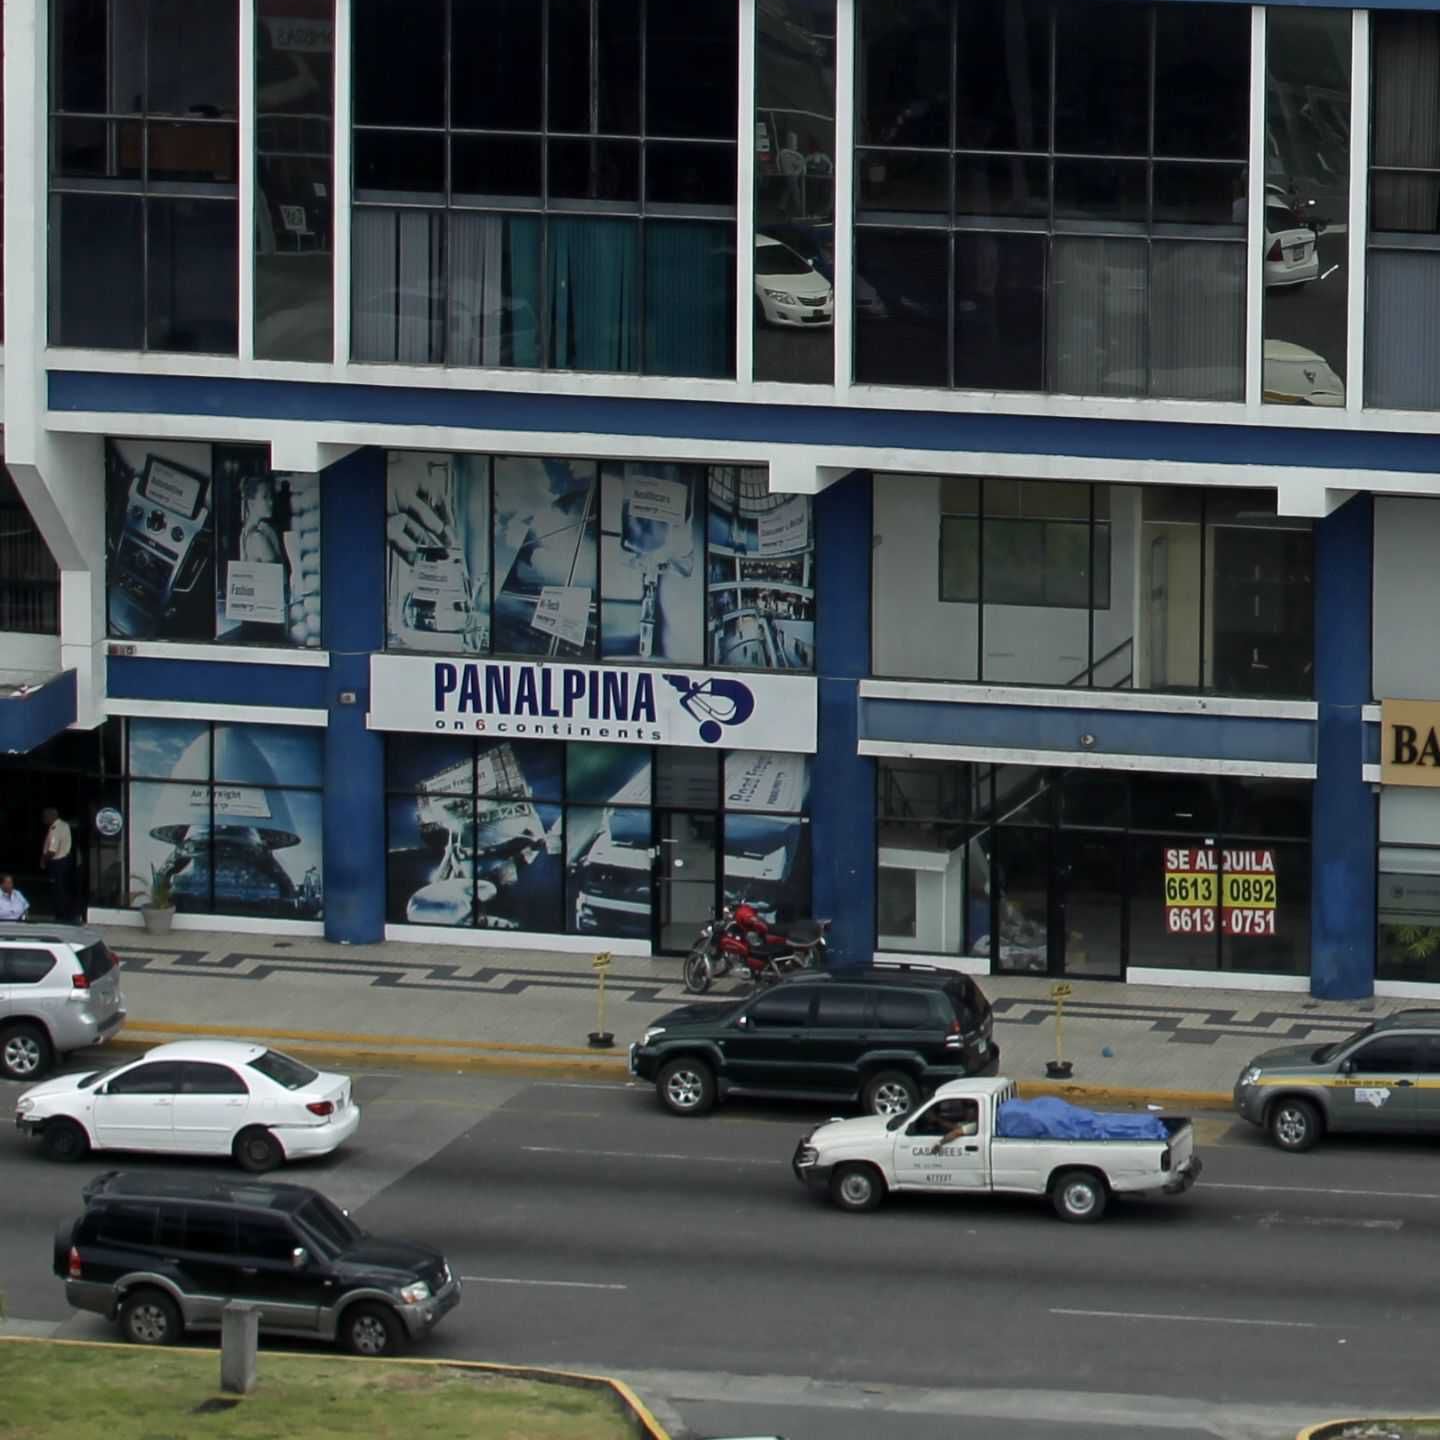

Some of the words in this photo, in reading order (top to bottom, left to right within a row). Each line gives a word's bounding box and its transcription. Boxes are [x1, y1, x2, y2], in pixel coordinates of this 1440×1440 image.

[434, 662, 657, 723] PANALPINA
[435, 719, 465, 731] on
[475, 719, 487, 732] 6
[496, 722, 662, 742] continents
[1166, 848, 1190, 870] SE
[1195, 849, 1275, 872] ALQUILA
[1166, 877, 1213, 901] 6613
[1229, 878, 1276, 902] 0892
[1168, 907, 1216, 932] 6613
[1231, 908, 1276, 934] 0751
